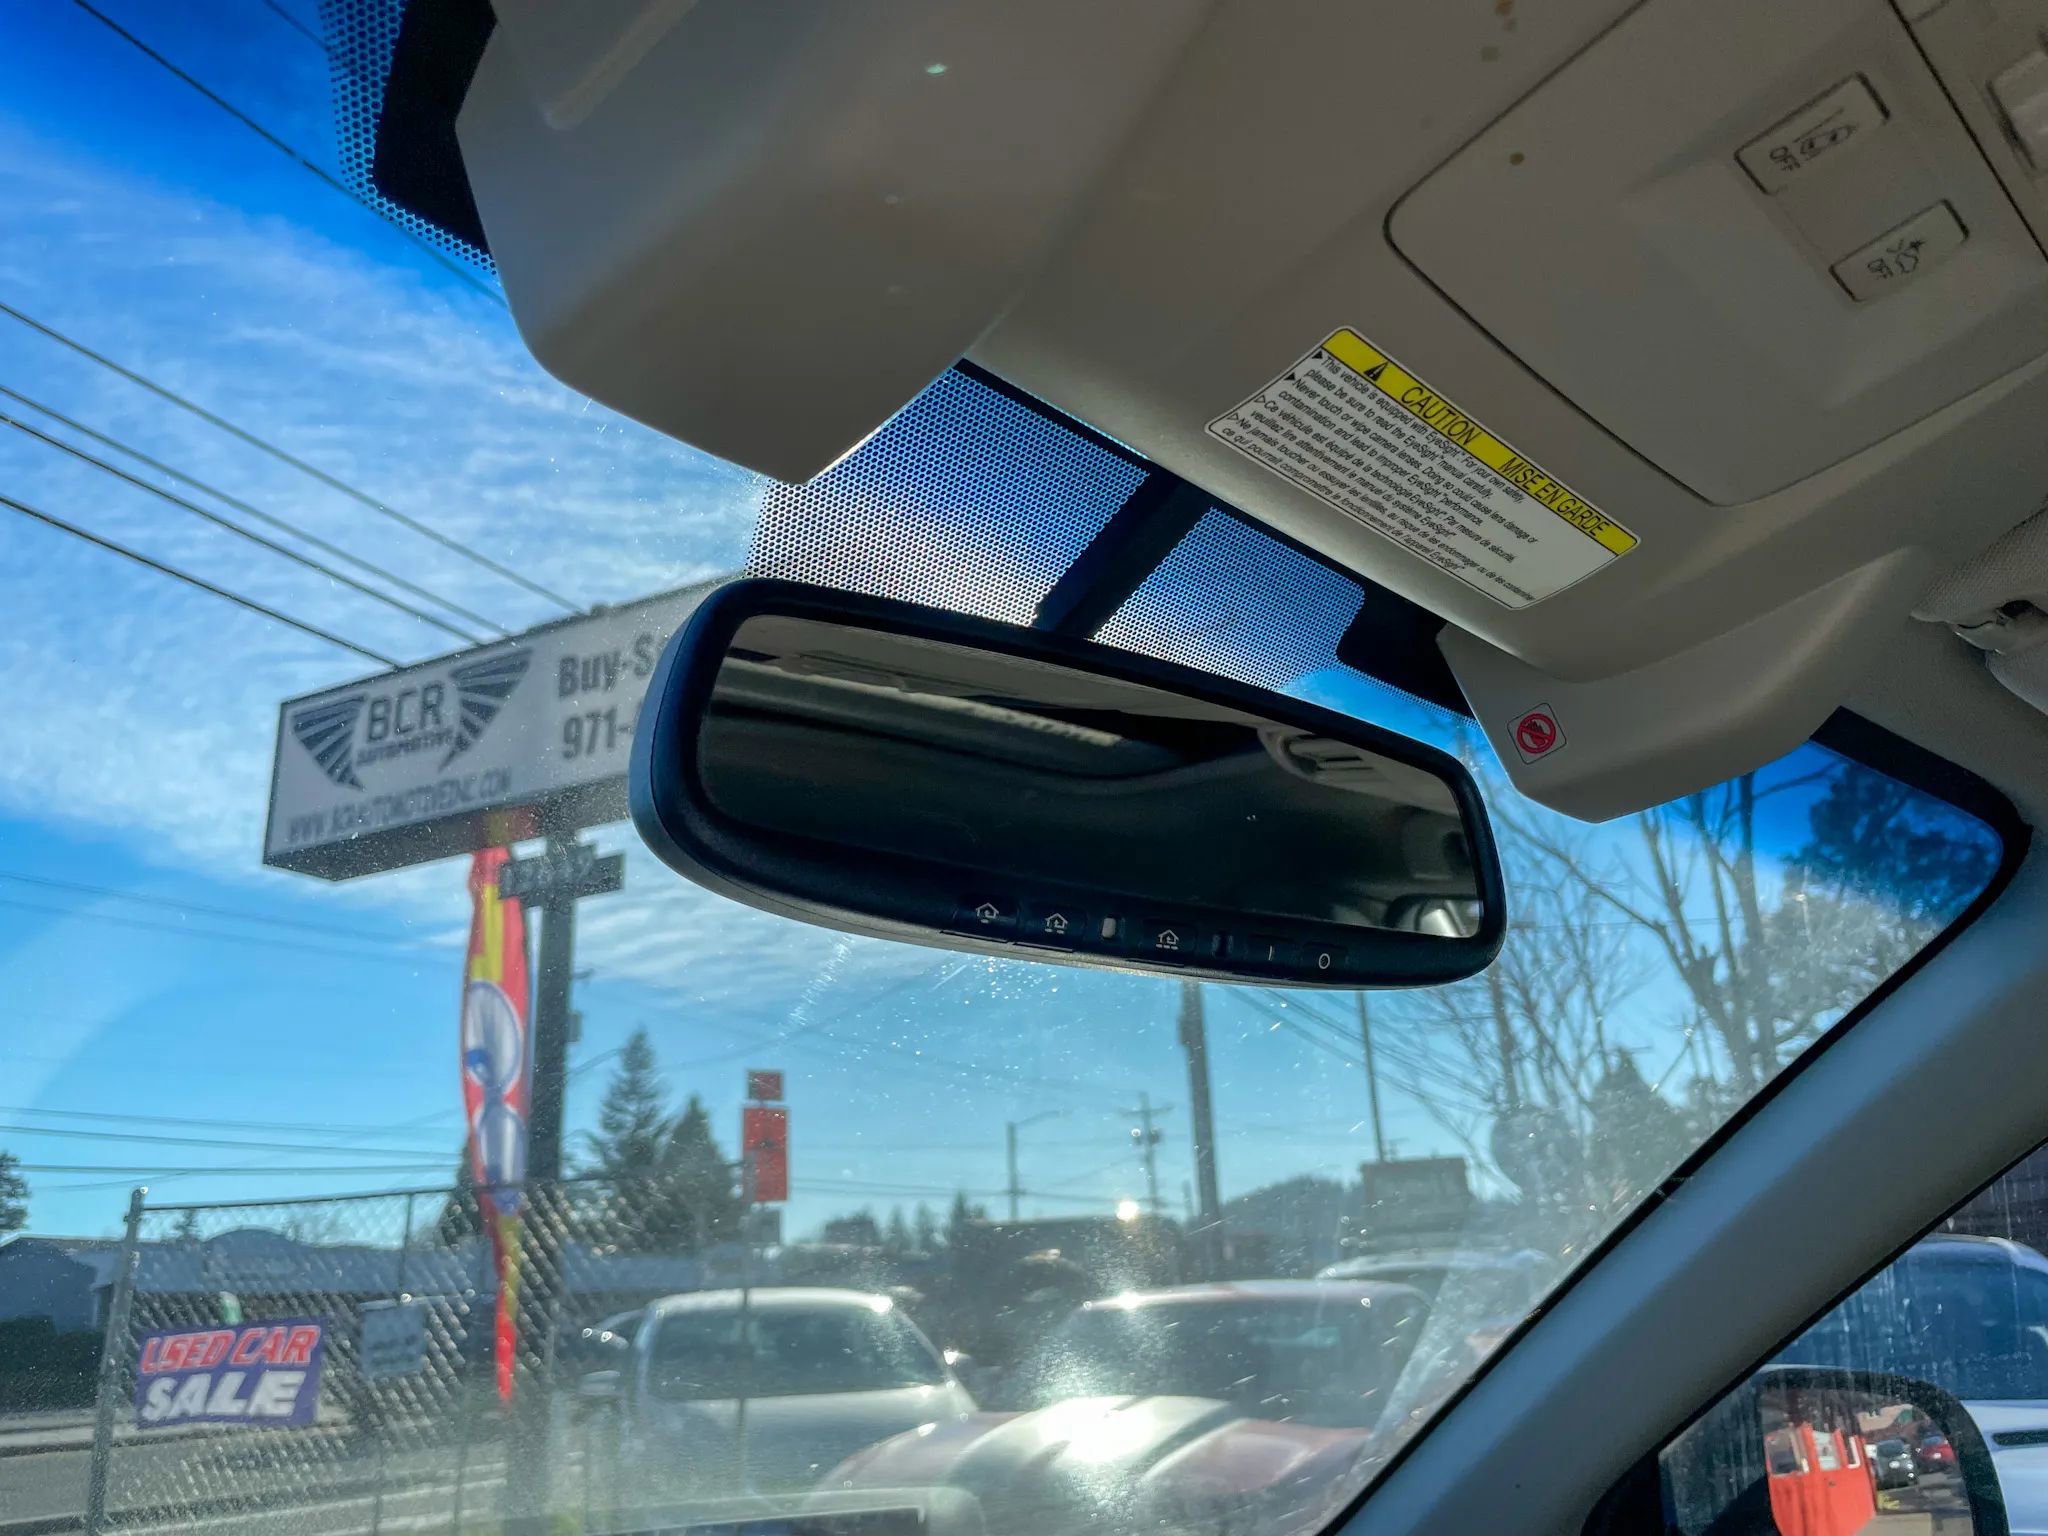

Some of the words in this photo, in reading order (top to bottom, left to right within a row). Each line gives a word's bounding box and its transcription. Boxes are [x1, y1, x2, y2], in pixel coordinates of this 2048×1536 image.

[1303, 368, 1336, 391] please
[1333, 386, 1348, 399] be
[1345, 396, 1366, 412] sure
[1363, 407, 1375, 418] to
[1372, 415, 1395, 430] read
[1390, 426, 1406, 439] the
[1437, 459, 1466, 479] manual
[1462, 477, 1492, 498] carefully.
[1321, 355, 1341, 374] This
[1339, 371, 1369, 394] vehicle
[1366, 389, 1378, 400] is
[1375, 397, 1414, 424] equipped
[1409, 421, 1428, 435] with
[1460, 455, 1477, 468] For
[1471, 467, 1492, 479] your
[1488, 476, 1505, 488] own
[1501, 486, 1524, 503] safety,
[1400, 386, 1480, 445] CAUTION
[1221, 427, 1235, 436] ce
[1233, 434, 1252, 445] qui
[1245, 443, 1283, 465] pourrait
[1279, 463, 1333, 495] compromettre
[1330, 492, 1341, 500] le
[1235, 417, 1251, 429] Ne
[1246, 426, 1279, 446] jamais
[1276, 443, 1309, 464] toucher
[1306, 463, 1320, 472] ou
[1317, 470, 1350, 489] essuyer
[1346, 486, 1361, 497] les
[1386, 512, 1399, 520] au
[1397, 518, 1420, 532] risque
[1417, 530, 1430, 538] de
[1427, 535, 1440, 544] les
[1250, 411, 1284, 433] veuillez
[1281, 429, 1297, 441] lire
[1295, 439, 1350, 473] attentivement
[1346, 470, 1357, 478] le
[1354, 476, 1386, 495] manuel
[1381, 493, 1394, 502] du
[1263, 400, 1279, 412] Ce
[1278, 410, 1313, 434] véhicule
[1311, 432, 1328, 444] est
[1324, 440, 1355, 460] équipé
[1351, 458, 1364, 467] de
[1361, 463, 1373, 472] la
[1370, 469, 1412, 497] technologie
[1443, 515, 1459, 526] Par
[1455, 524, 1482, 541] mesure
[1479, 539, 1491, 547] de
[1278, 390, 1336, 429] contamination
[1333, 427, 1354, 440] and
[1349, 436, 1371, 452] lead
[1366, 448, 1378, 457] to
[1375, 454, 1410, 477] improper
[1438, 496, 1483, 526] performance.
[1291, 378, 1320, 399] Never
[1317, 396, 1342, 415] touch
[1340, 412, 1354, 421] or
[1350, 419, 1371, 434] wipe
[1368, 432, 1399, 453] camera
[1396, 449, 1422, 470] lenses.
[1421, 465, 1445, 485] Doing
[1441, 481, 1454, 490] so
[1451, 487, 1475, 502] could
[1469, 499, 1492, 514] cause
[1489, 511, 1506, 523] lens
[1503, 521, 1530, 539] damage
[1499, 457, 1544, 489] MISE
[1533, 482, 1565, 504] EN
[1556, 498, 1609, 536] GARDE
[558, 632, 665, 699] Buy-S
[366, 679, 446, 744] BCR
[561, 703, 640, 759] 971-
[140, 1329, 236, 1375] USED
[229, 1324, 321, 1366] CAR
[142, 1370, 307, 1421] SALE
